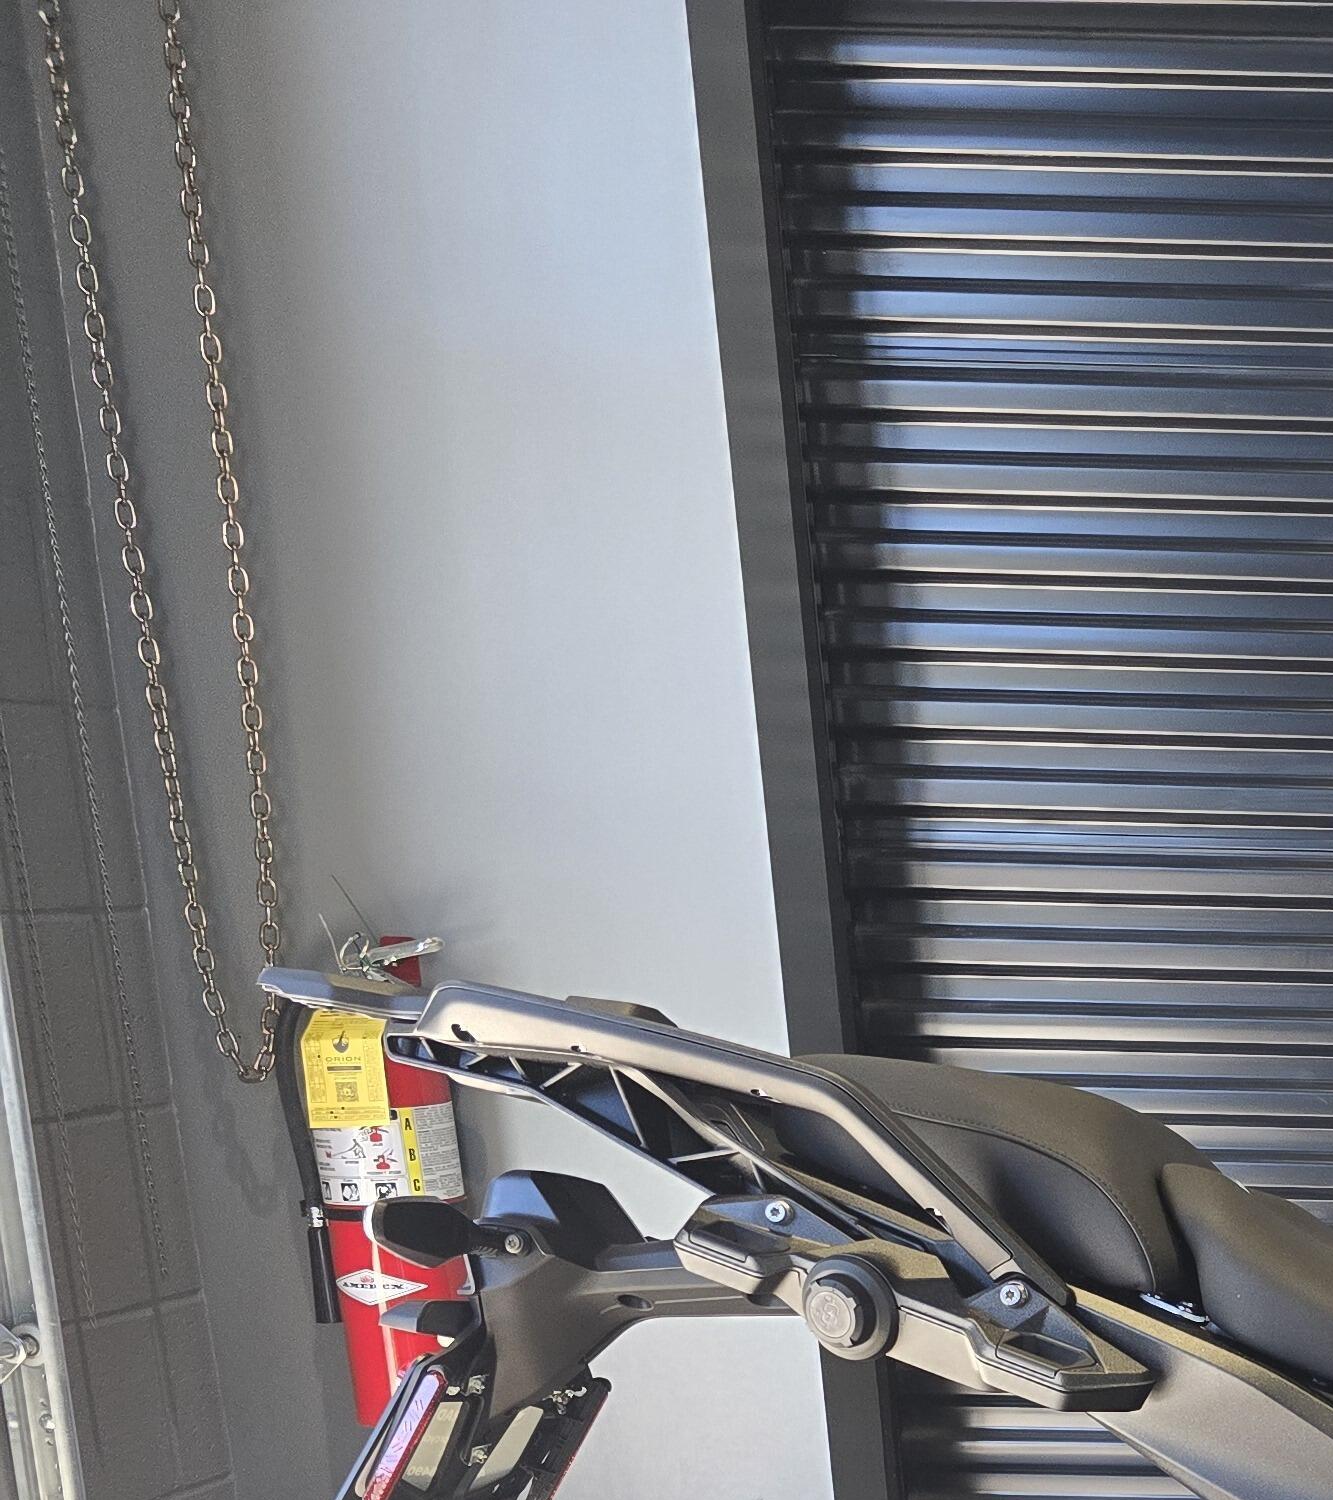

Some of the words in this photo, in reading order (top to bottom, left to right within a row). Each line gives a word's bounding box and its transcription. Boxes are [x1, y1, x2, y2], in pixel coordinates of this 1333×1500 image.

[405, 1118, 413, 1131] A
[409, 1148, 416, 1161] B
[413, 1179, 421, 1192] C
